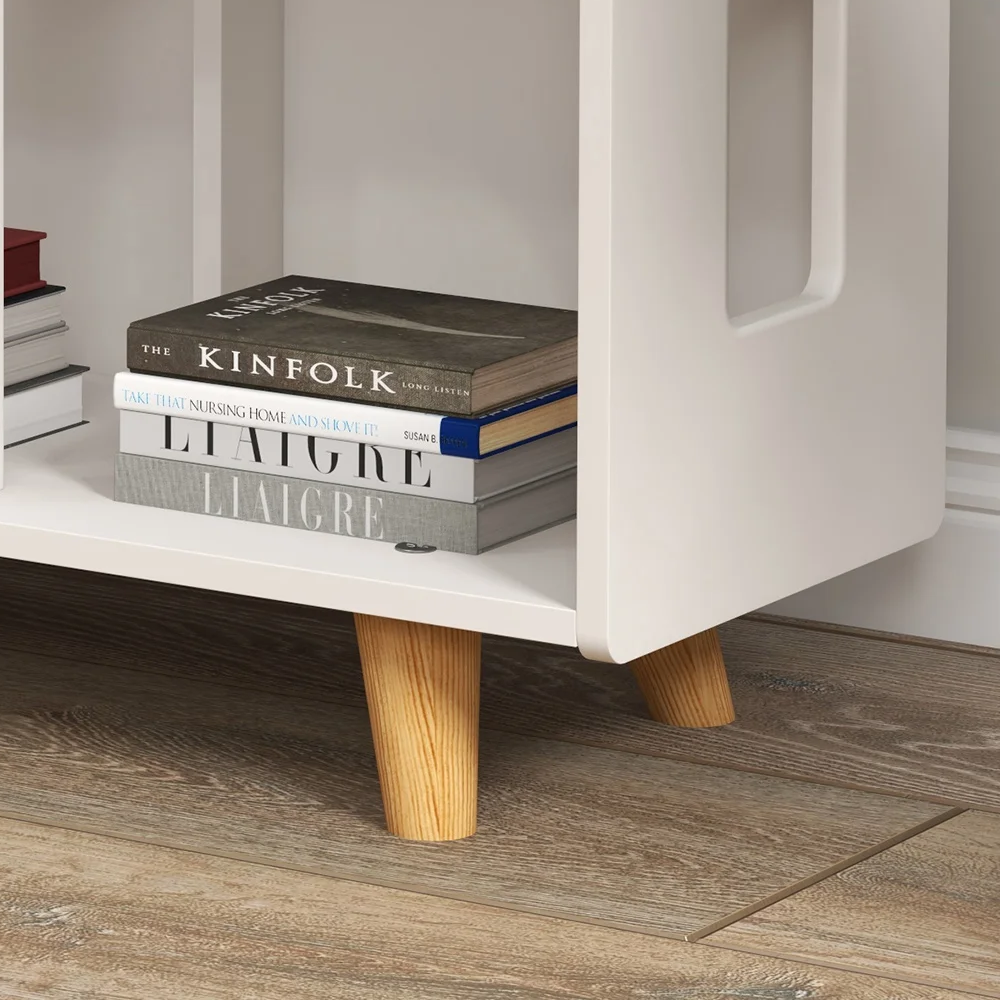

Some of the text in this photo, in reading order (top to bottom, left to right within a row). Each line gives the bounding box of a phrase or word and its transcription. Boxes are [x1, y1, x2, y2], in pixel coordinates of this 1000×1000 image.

[205, 286, 326, 320] KINFOLK
[141, 344, 470, 396] THE KINFOLK LONG LISTEN
[122, 389, 151, 405] TAKE
[154, 393, 187, 410] THAT
[189, 399, 246, 418] NURSING
[249, 407, 287, 424] HOME
[289, 414, 318, 428] AND
[320, 417, 361, 434] SHOVE
[403, 430, 429, 442] SUSAN
[430, 434, 438, 444] B.
[204, 472, 384, 540] LIAIGRE
